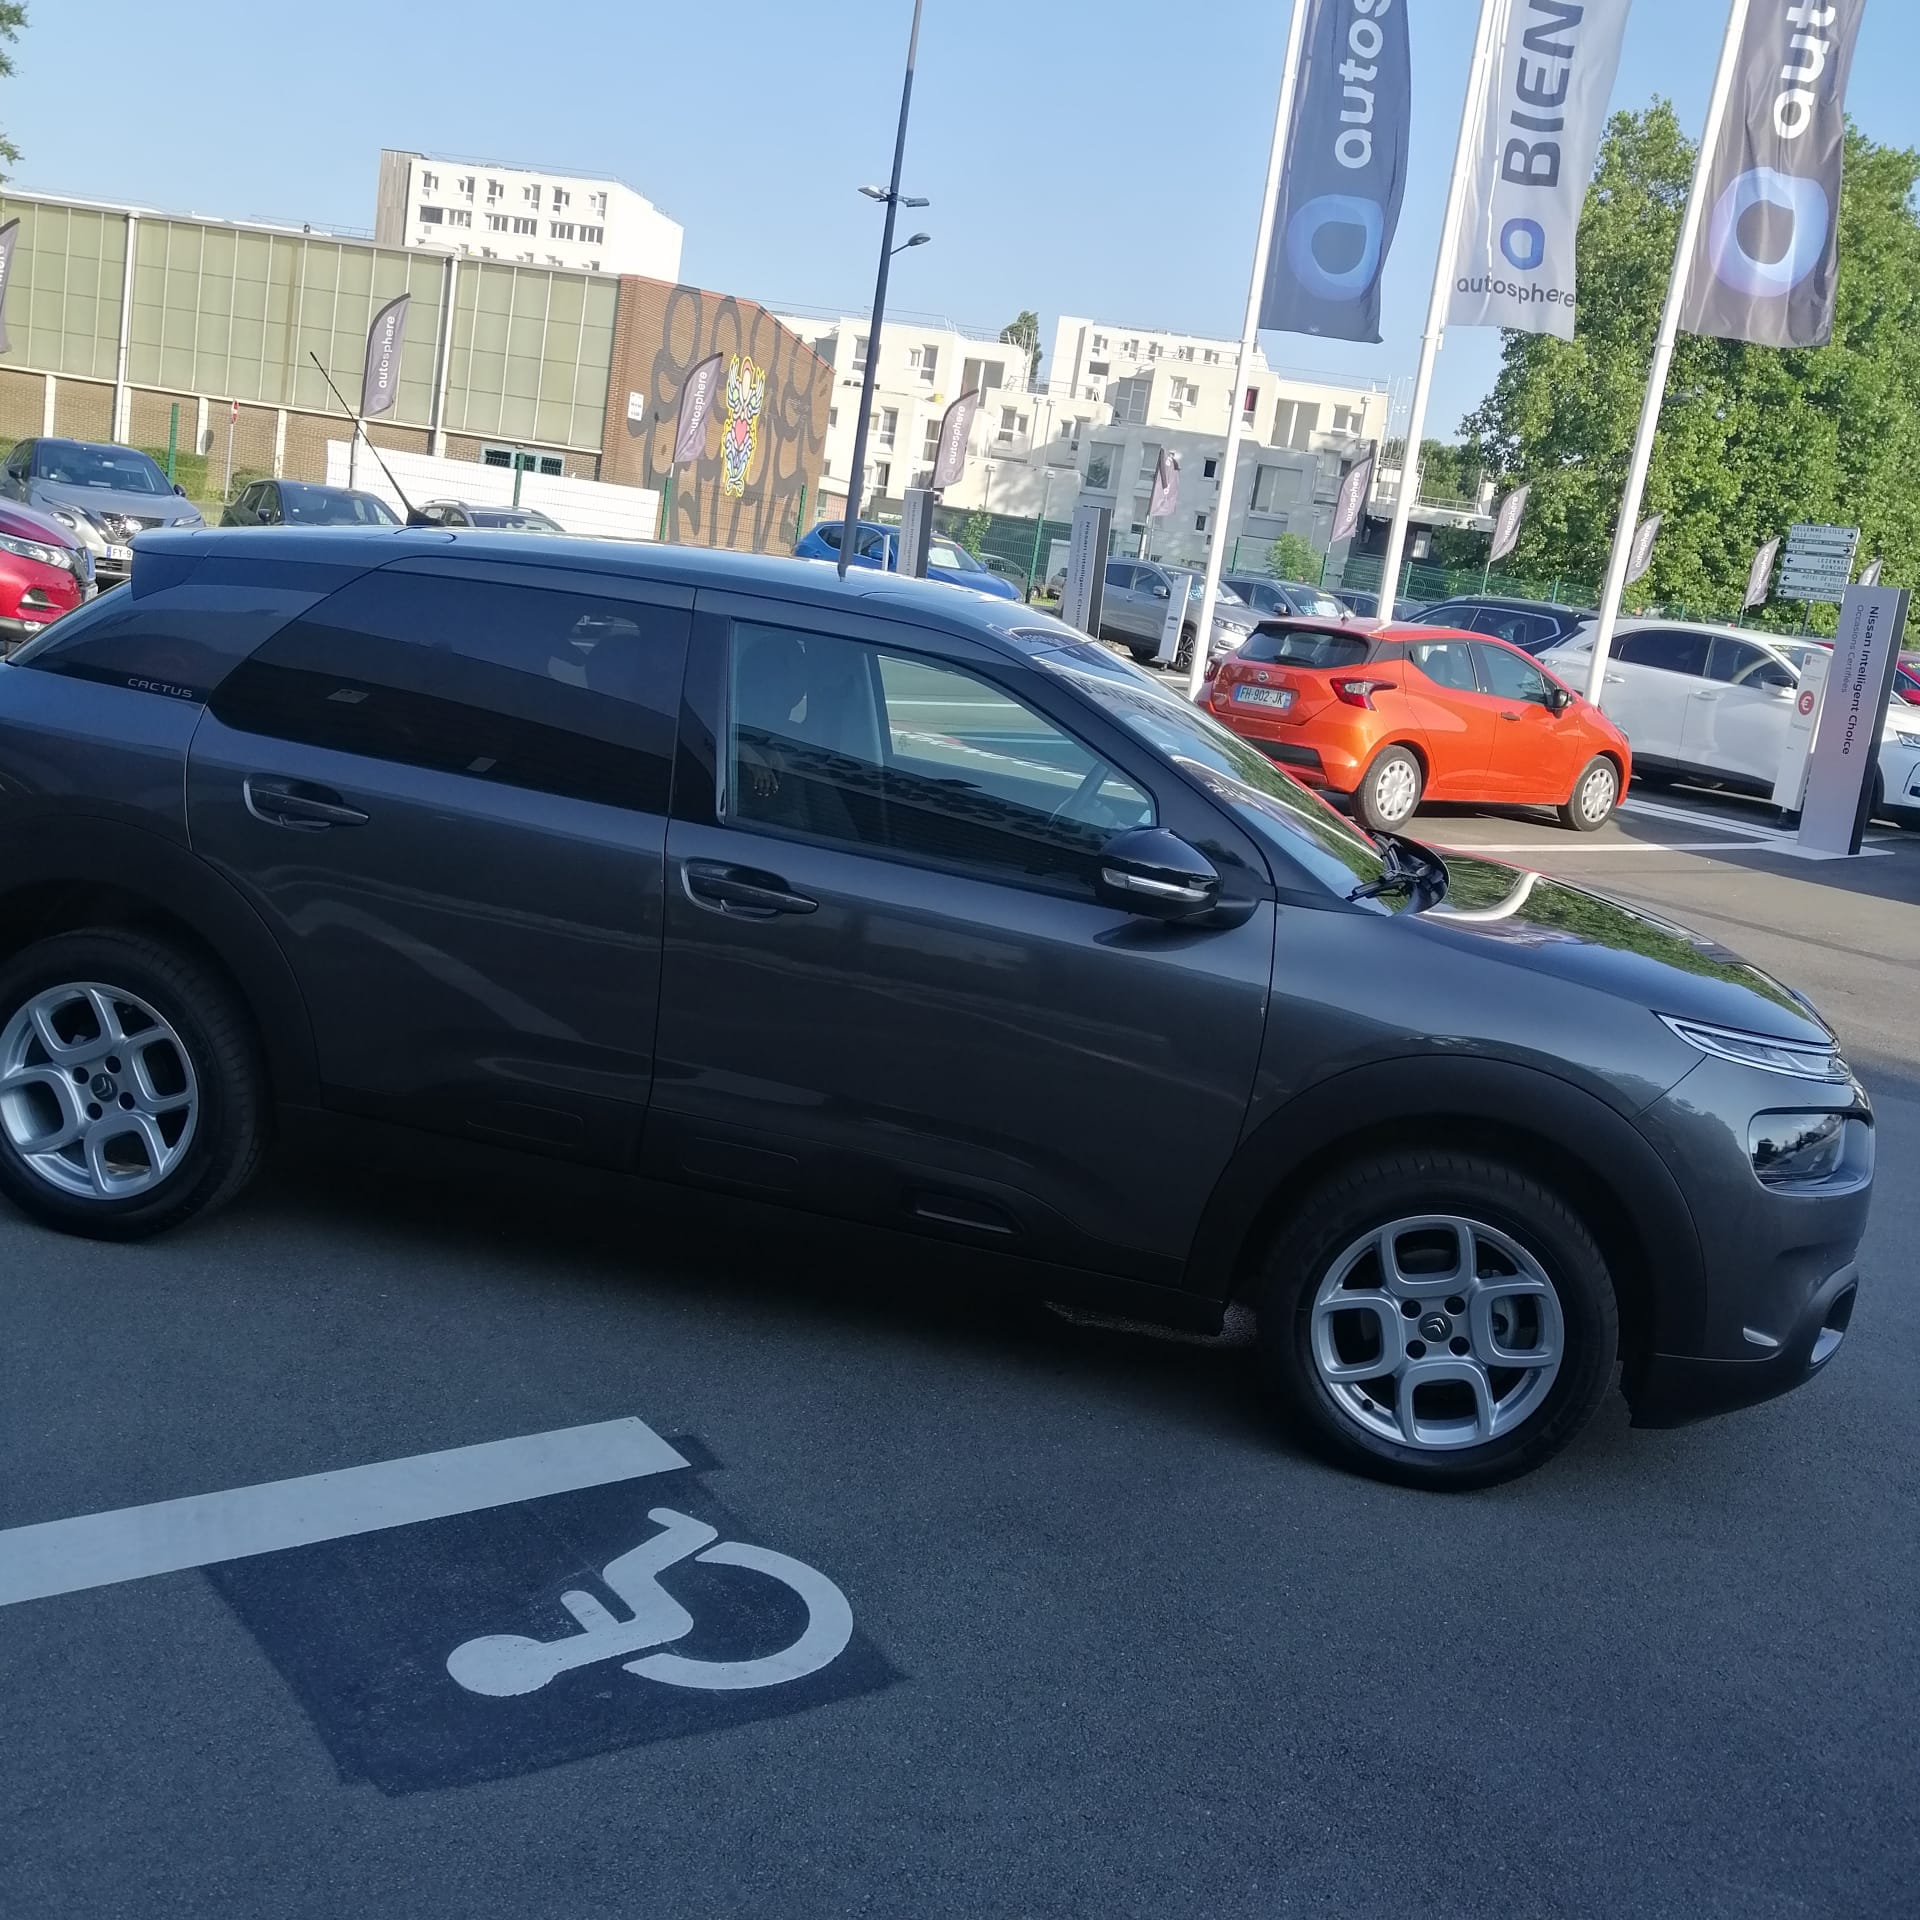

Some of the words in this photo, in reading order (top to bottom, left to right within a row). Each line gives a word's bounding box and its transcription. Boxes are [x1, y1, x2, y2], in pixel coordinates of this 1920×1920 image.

[1501, 0, 1584, 187] BIEN
[1773, 0, 1836, 139] aut
[1456, 274, 1575, 307] autosphere
[378, 315, 396, 389] autosphere
[949, 405, 966, 465] autosphere
[1346, 471, 1361, 522] autosphere
[1849, 604, 1864, 650] Occasions
[1864, 605, 1880, 647] Nissan
[127, 678, 193, 698] CACTUS
[1240, 687, 1286, 705] FH-902-JK
[1850, 650, 1871, 713] Intelligent
[1842, 714, 1858, 755] Choice
